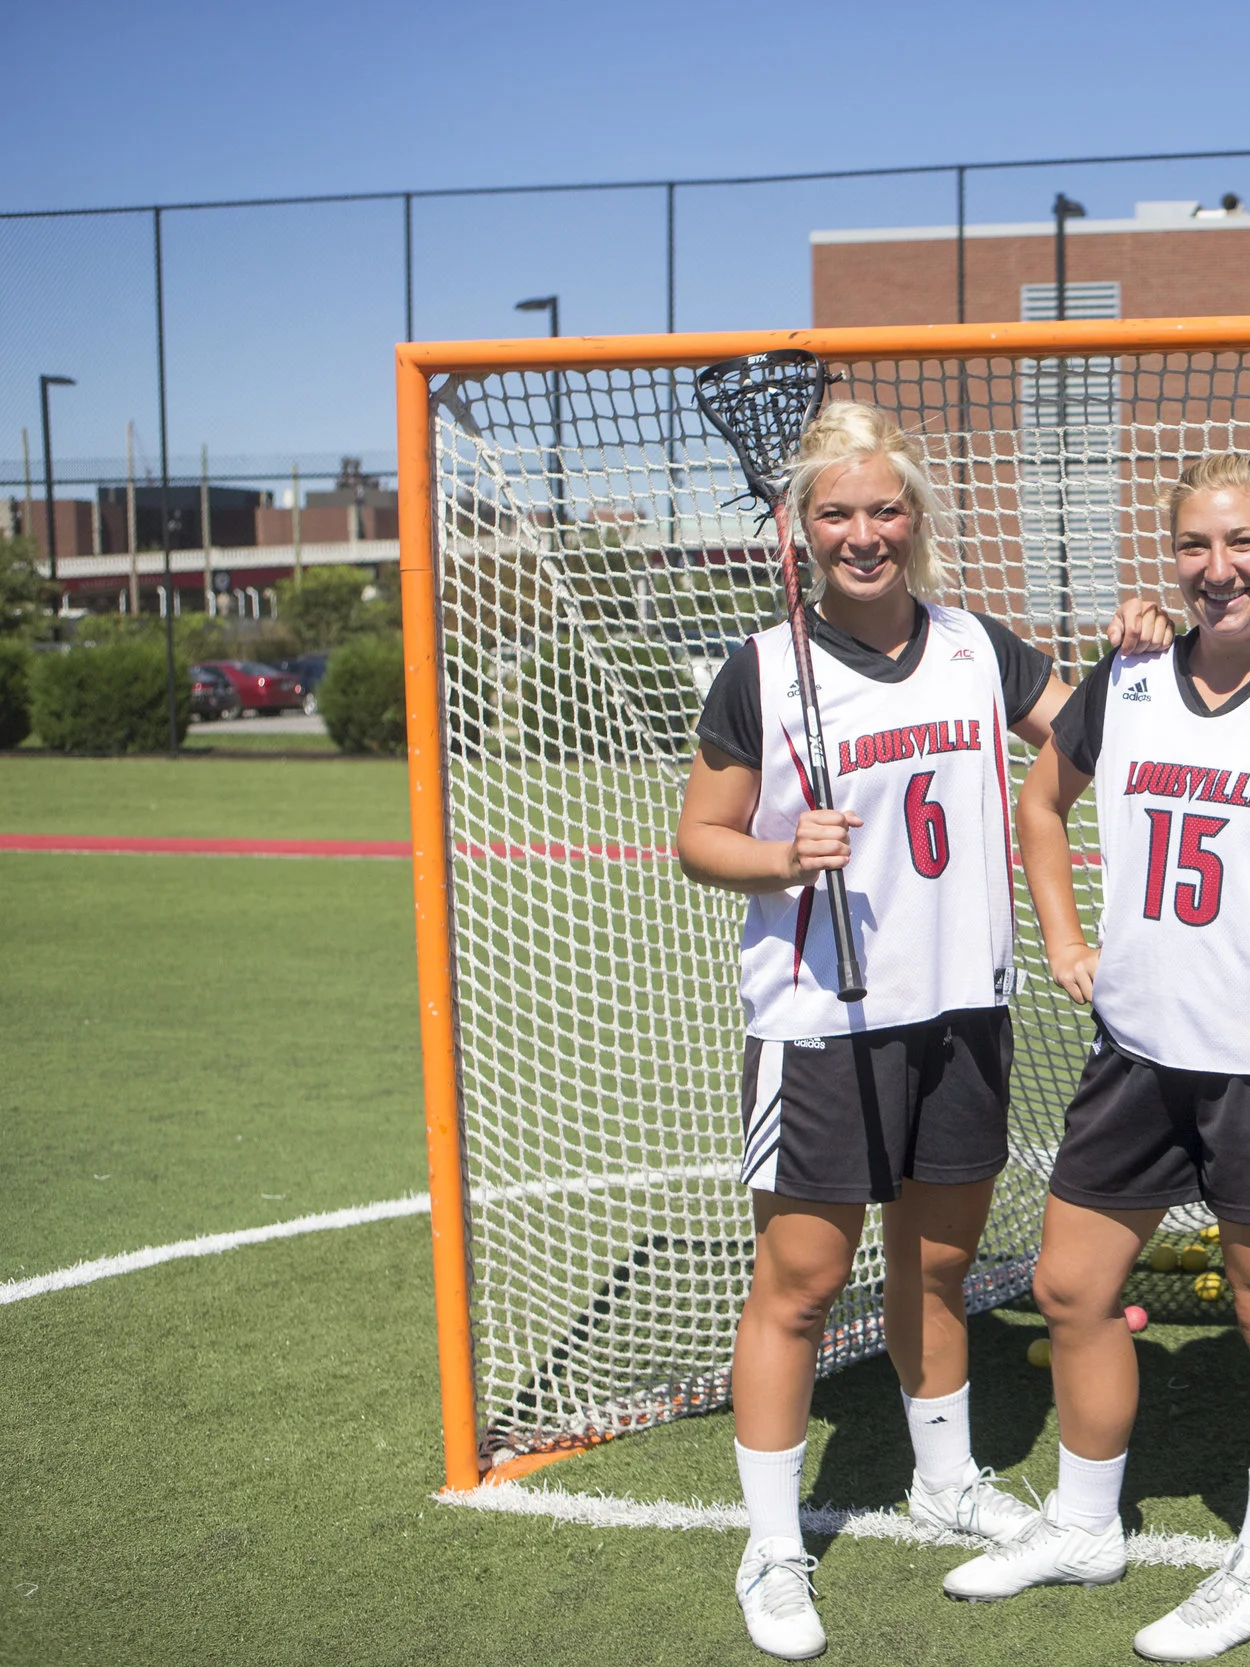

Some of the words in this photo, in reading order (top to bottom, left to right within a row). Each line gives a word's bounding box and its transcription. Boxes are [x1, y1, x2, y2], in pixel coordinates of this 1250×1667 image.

[747, 353, 768, 365] STX
[952, 649, 974, 659] AC
[787, 684, 823, 698] ads
[837, 719, 982, 777] LOUISVILLE
[904, 770, 950, 879] 6
[1143, 808, 1230, 927] 15
[794, 1039, 826, 1050] adidas
